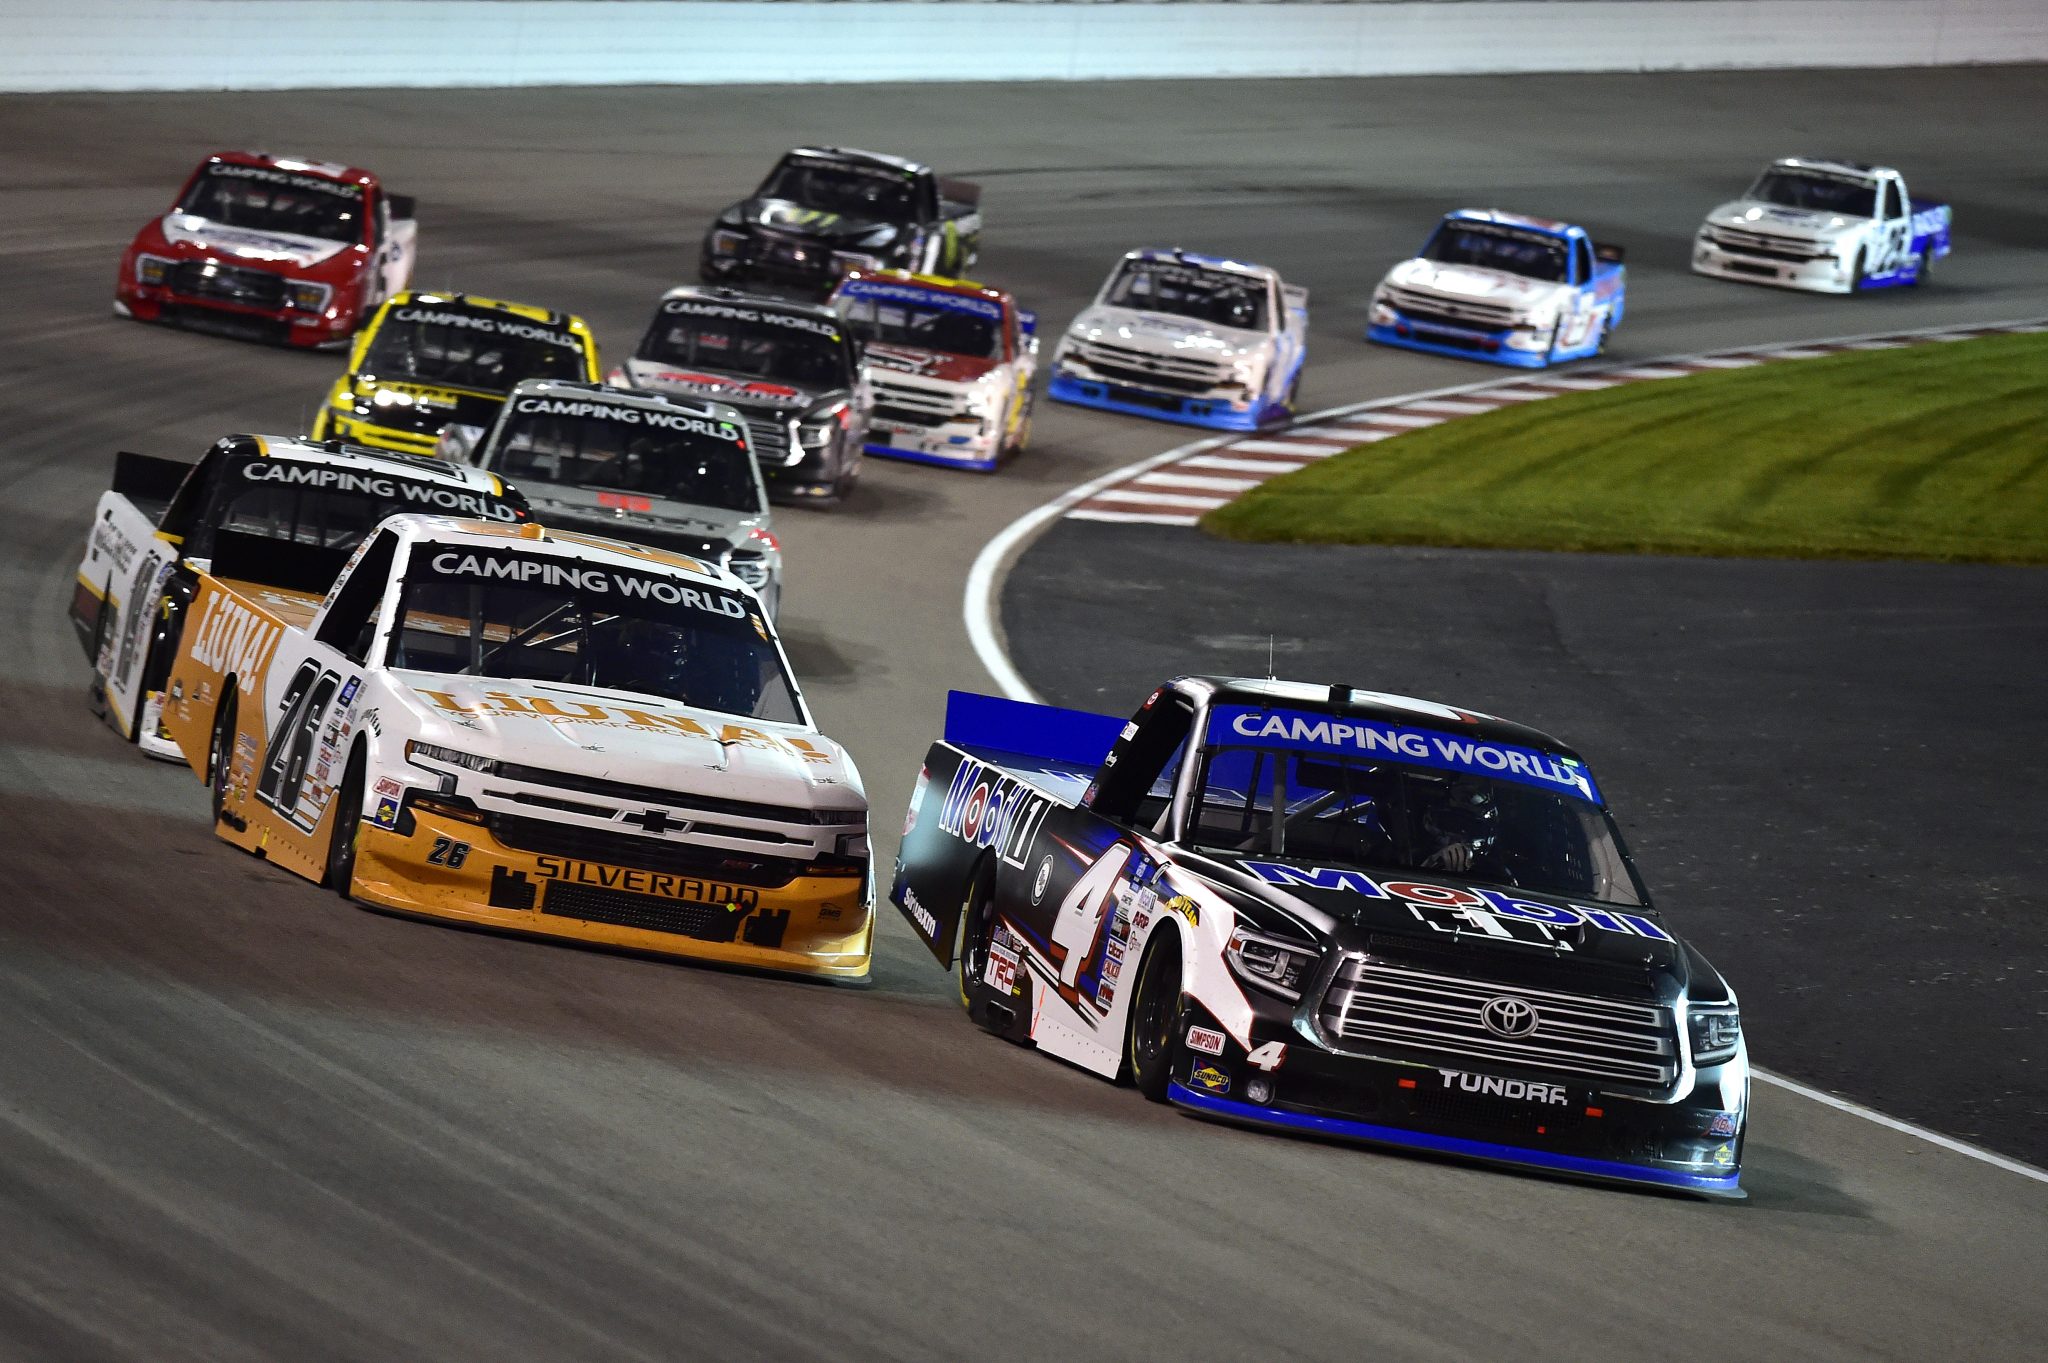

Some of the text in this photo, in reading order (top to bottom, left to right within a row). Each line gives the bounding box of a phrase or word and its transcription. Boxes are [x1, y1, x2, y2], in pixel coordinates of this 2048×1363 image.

[209, 165, 354, 197] CAMPING WORLD
[395, 308, 576, 348] CAMPING WORLD
[665, 302, 836, 336] CAMPING WORLD
[518, 399, 739, 441] CAMPING WORLD
[242, 463, 516, 523] CAMPING WORLD
[432, 553, 746, 619] CAMPING WORLD
[254, 656, 342, 824] 26
[1233, 713, 1578, 786] CAMPING WORLD
[938, 755, 1033, 859] Mobil
[425, 836, 472, 870] 26
[534, 856, 759, 909] SILVERADO
[1235, 860, 1677, 945] Mobil
[1051, 841, 1132, 989] 4
[1132, 910, 1150, 930] ARP
[989, 951, 1016, 991] TRD
[1189, 1030, 1221, 1051] SIMPSON
[1246, 1040, 1287, 1072] 4
[1195, 1070, 1228, 1085] SUNOCO
[1438, 1068, 1568, 1106] TUNDRA
